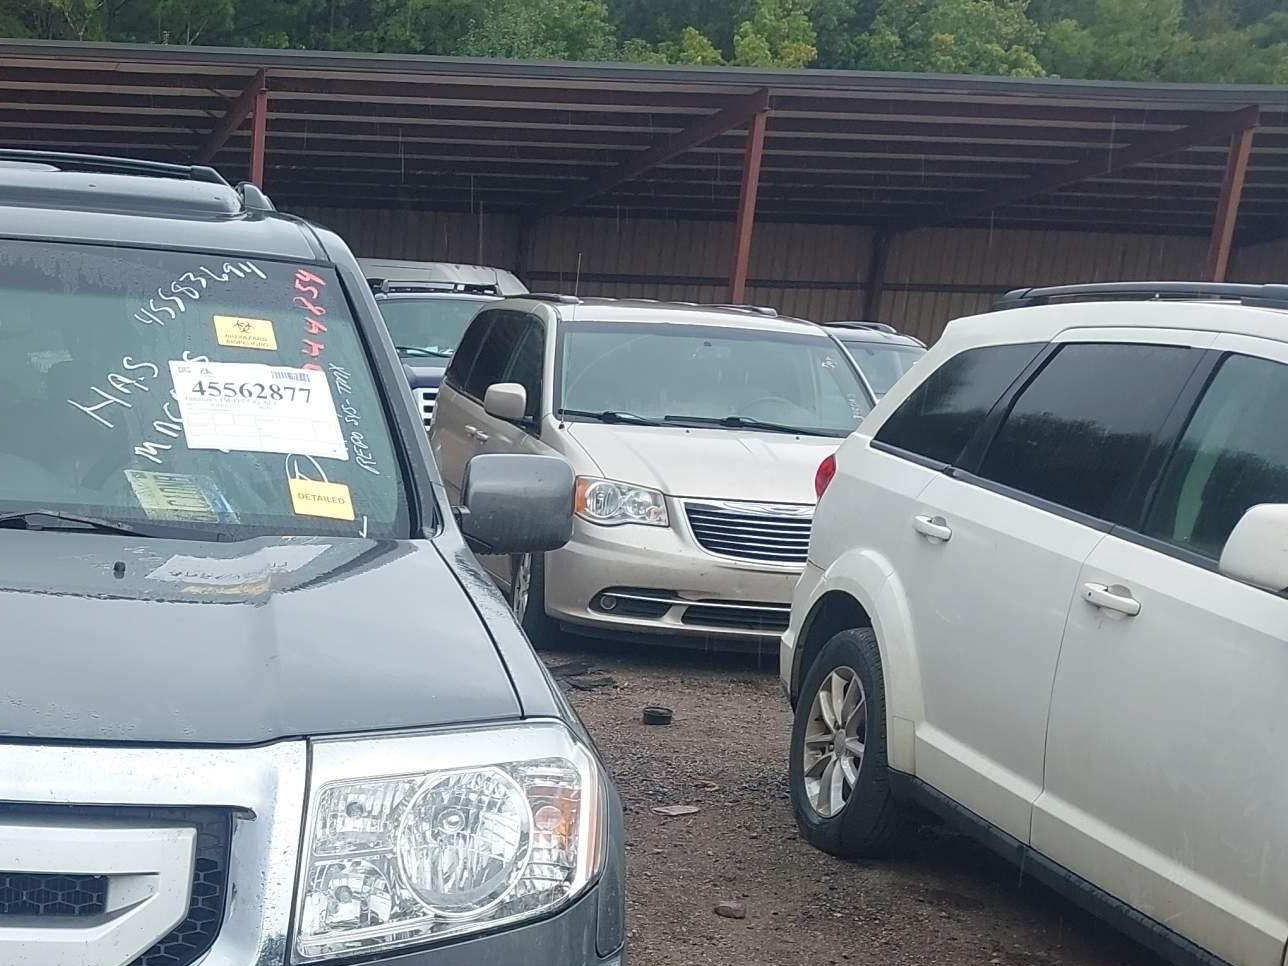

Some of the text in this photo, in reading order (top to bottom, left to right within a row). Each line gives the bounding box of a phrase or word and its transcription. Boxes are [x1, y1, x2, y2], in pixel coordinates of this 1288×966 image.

[68, 356, 159, 428] HAS
[191, 379, 312, 404] 45562877
[297, 491, 345, 505] DETAILED
